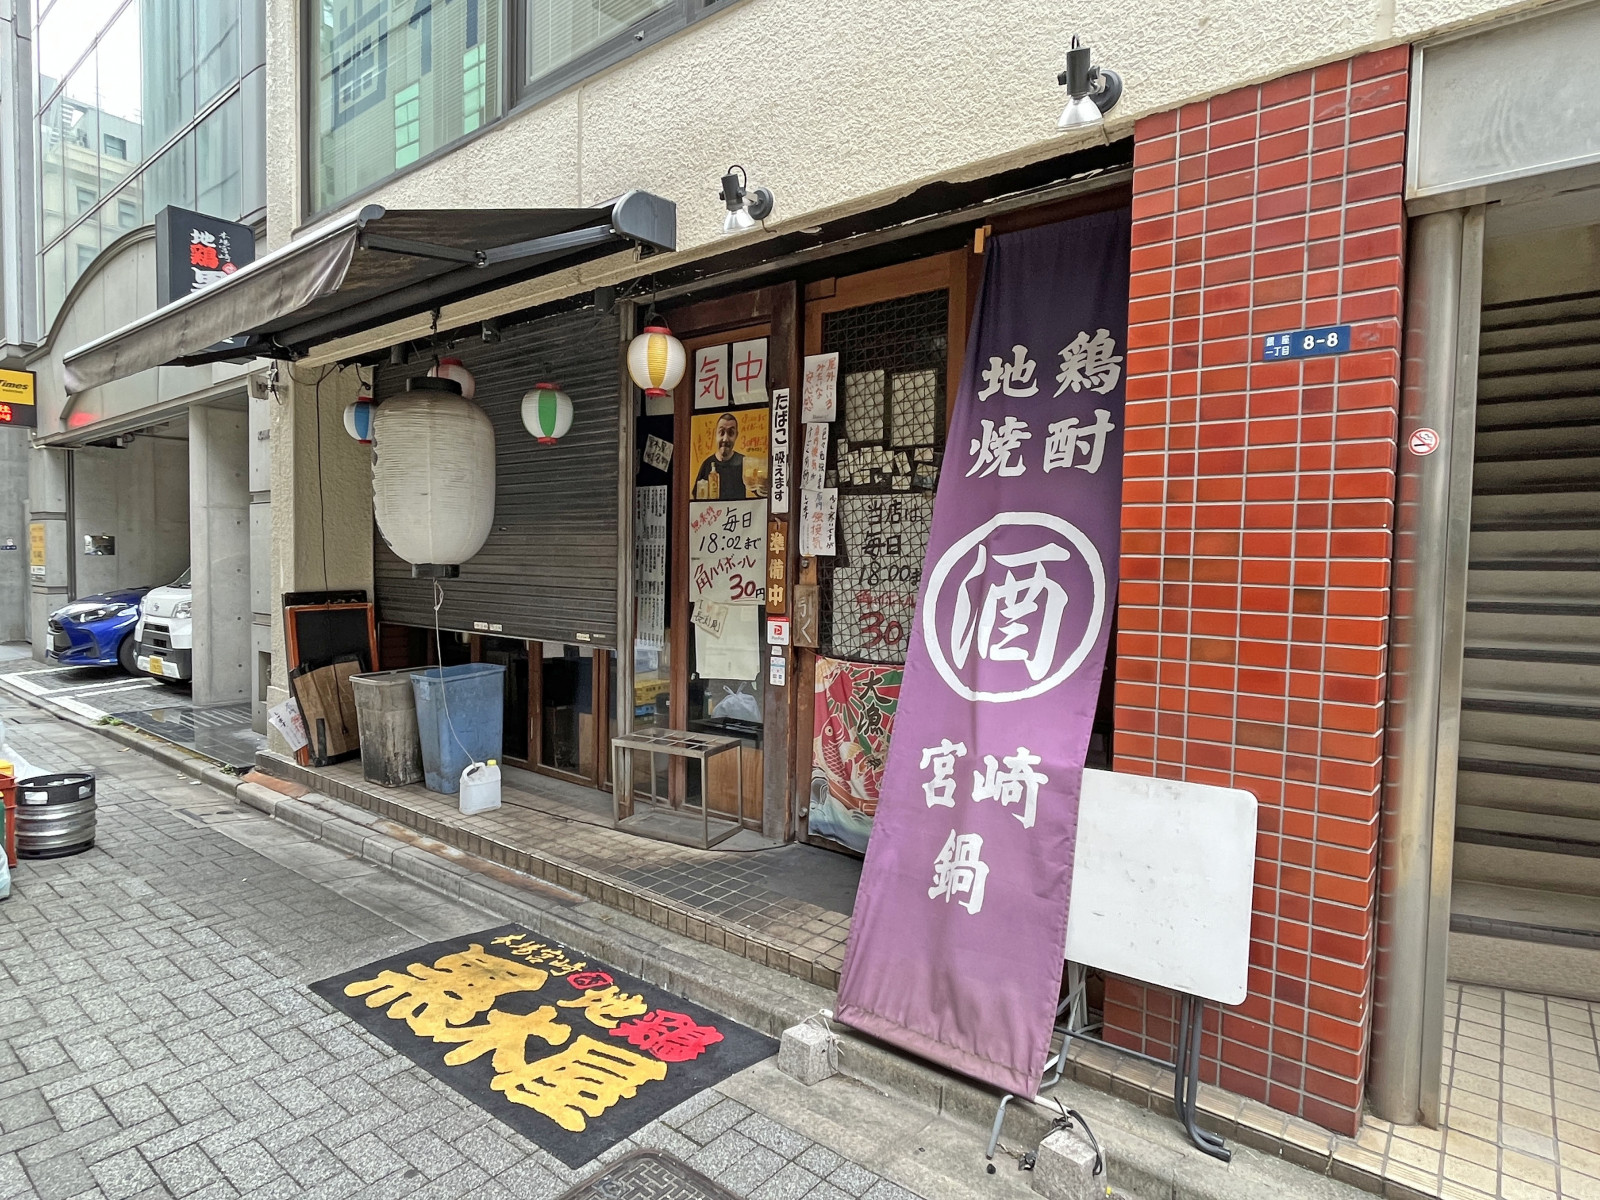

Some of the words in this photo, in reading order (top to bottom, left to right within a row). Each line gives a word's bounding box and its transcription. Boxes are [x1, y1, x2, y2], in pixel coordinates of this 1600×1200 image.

[1265, 345, 1290, 357] 一丁目
[1266, 335, 1290, 347] 銀座
[1303, 332, 1338, 350] 8-8
[978, 328, 1124, 401] 地鶏
[965, 409, 1115, 478] 焼酎
[722, 507, 752, 532] 毎日
[699, 533, 761, 553] 18:02まで
[694, 553, 757, 594] 角ハイボール
[729, 573, 765, 601] 30円
[768, 531, 785, 606] 準備中
[798, 597, 813, 643] 引く
[859, 611, 911, 652] 30
[951, 542, 1071, 681] 酒
[857, 670, 892, 736] 大漁
[920, 738, 1049, 829] 宮崎
[928, 829, 990, 915] 鍋
